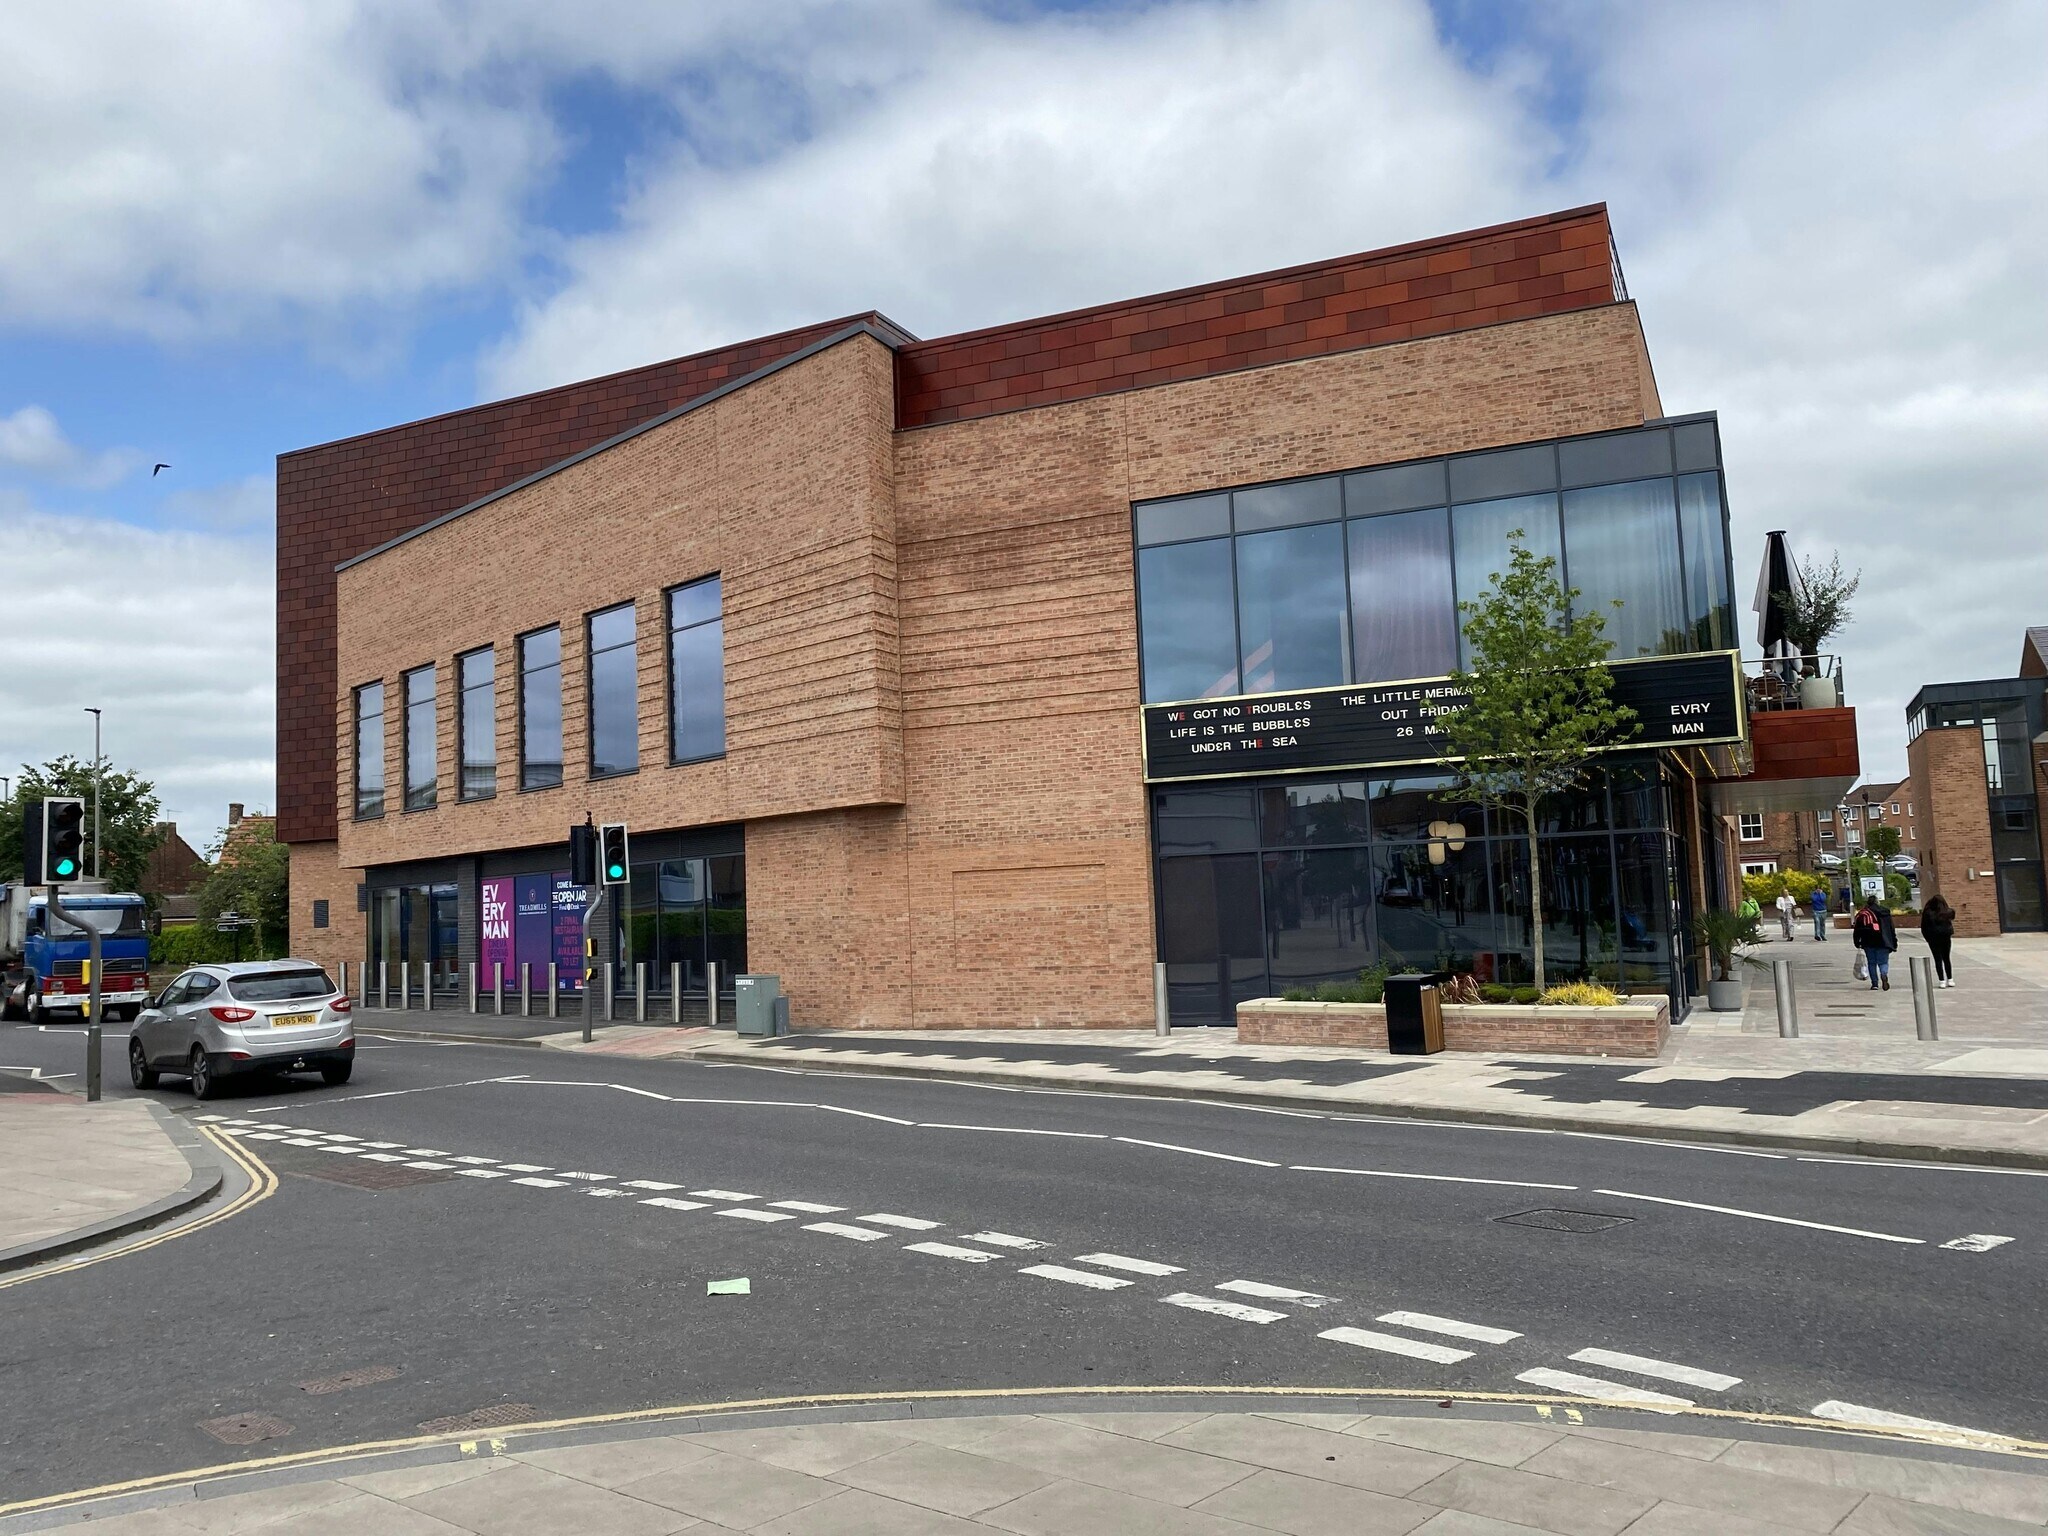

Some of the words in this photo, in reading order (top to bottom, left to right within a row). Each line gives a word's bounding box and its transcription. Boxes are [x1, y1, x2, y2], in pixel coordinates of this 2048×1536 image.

[1340, 694, 1367, 706] THE
[1373, 690, 1421, 704] LITTLE
[1425, 685, 1487, 699] MERMA
[1167, 711, 1186, 722] WE
[1193, 708, 1218, 720] GOT
[1223, 706, 1241, 717] NO
[1246, 700, 1312, 715] TROUBLES
[1381, 709, 1409, 721] OUT
[1670, 702, 1711, 715] EVRY
[1170, 727, 1197, 739] LIFE
[1203, 726, 1215, 736] IS
[1221, 723, 1245, 734] THE
[1252, 717, 1311, 732] BUBBLES
[1396, 726, 1414, 737] 26
[1672, 722, 1704, 735] MAN
[1191, 741, 1232, 754] UNDER
[1240, 738, 1263, 749] THE
[1272, 736, 1298, 747] SEA
[482, 884, 499, 903] EV
[558, 890, 575, 903] OPEN
[575, 889, 587, 902] JAR
[482, 902, 507, 921] ERY
[518, 903, 547, 912] TREADMILLS
[482, 920, 509, 940] MAN
[554, 925, 583, 935] RESTAURAN
